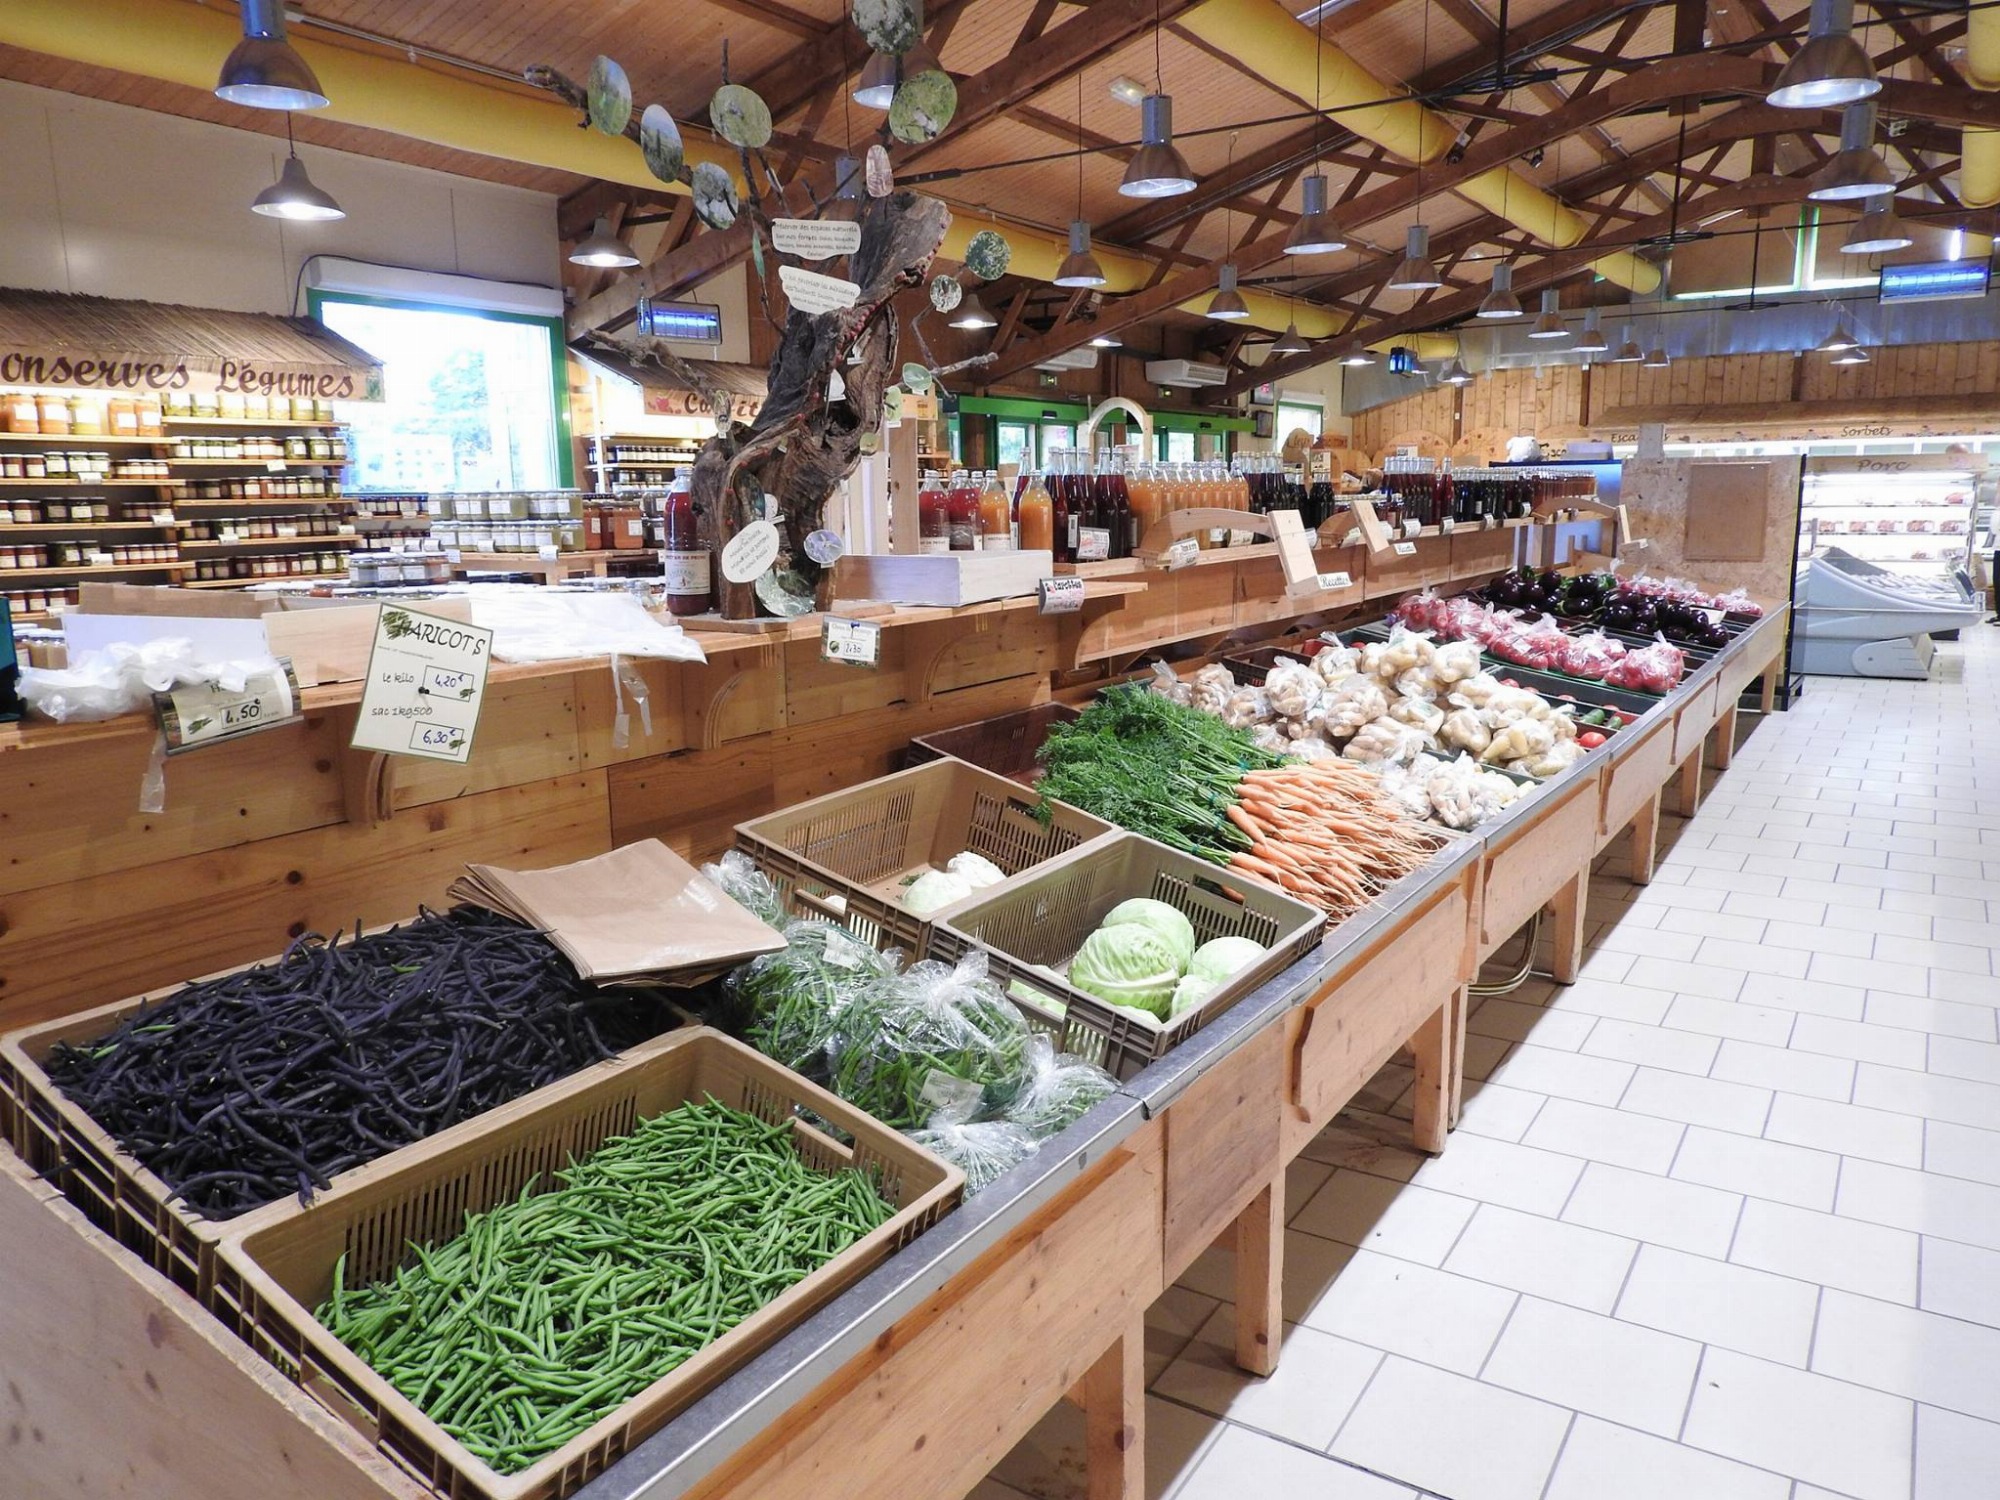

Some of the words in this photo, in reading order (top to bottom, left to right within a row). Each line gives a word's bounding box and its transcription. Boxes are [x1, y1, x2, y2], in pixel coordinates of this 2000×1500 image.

[215, 361, 354, 398] Légumes
[1840, 425, 1894, 438] Sorbets
[1857, 459, 1913, 472] Porc
